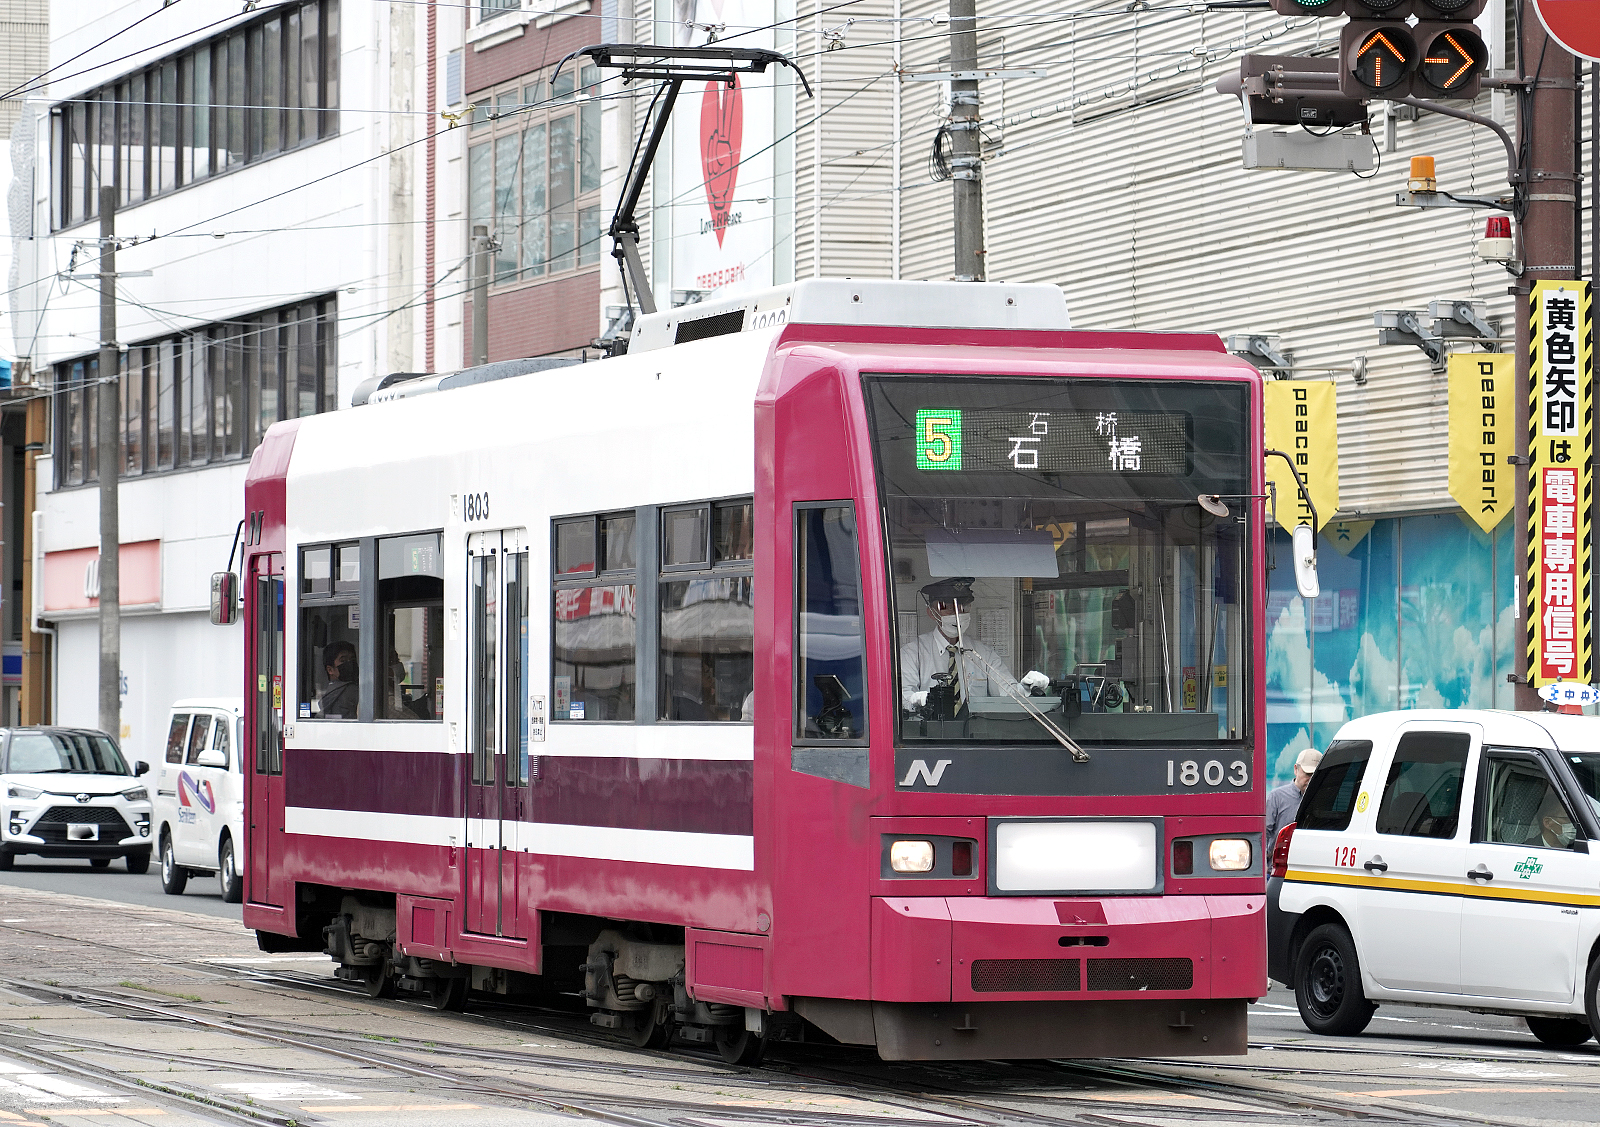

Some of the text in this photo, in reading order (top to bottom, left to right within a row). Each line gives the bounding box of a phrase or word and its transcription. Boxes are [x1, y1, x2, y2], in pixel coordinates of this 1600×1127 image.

[725, 261, 745, 288] park
[924, 417, 953, 462] 5
[1477, 362, 1498, 514] peace park
[1293, 388, 1312, 526] peace park
[463, 491, 489, 522] 1803
[1564, 688, 1591, 701] 中央
[1167, 760, 1249, 788] 1803
[1335, 846, 1357, 868] 126
